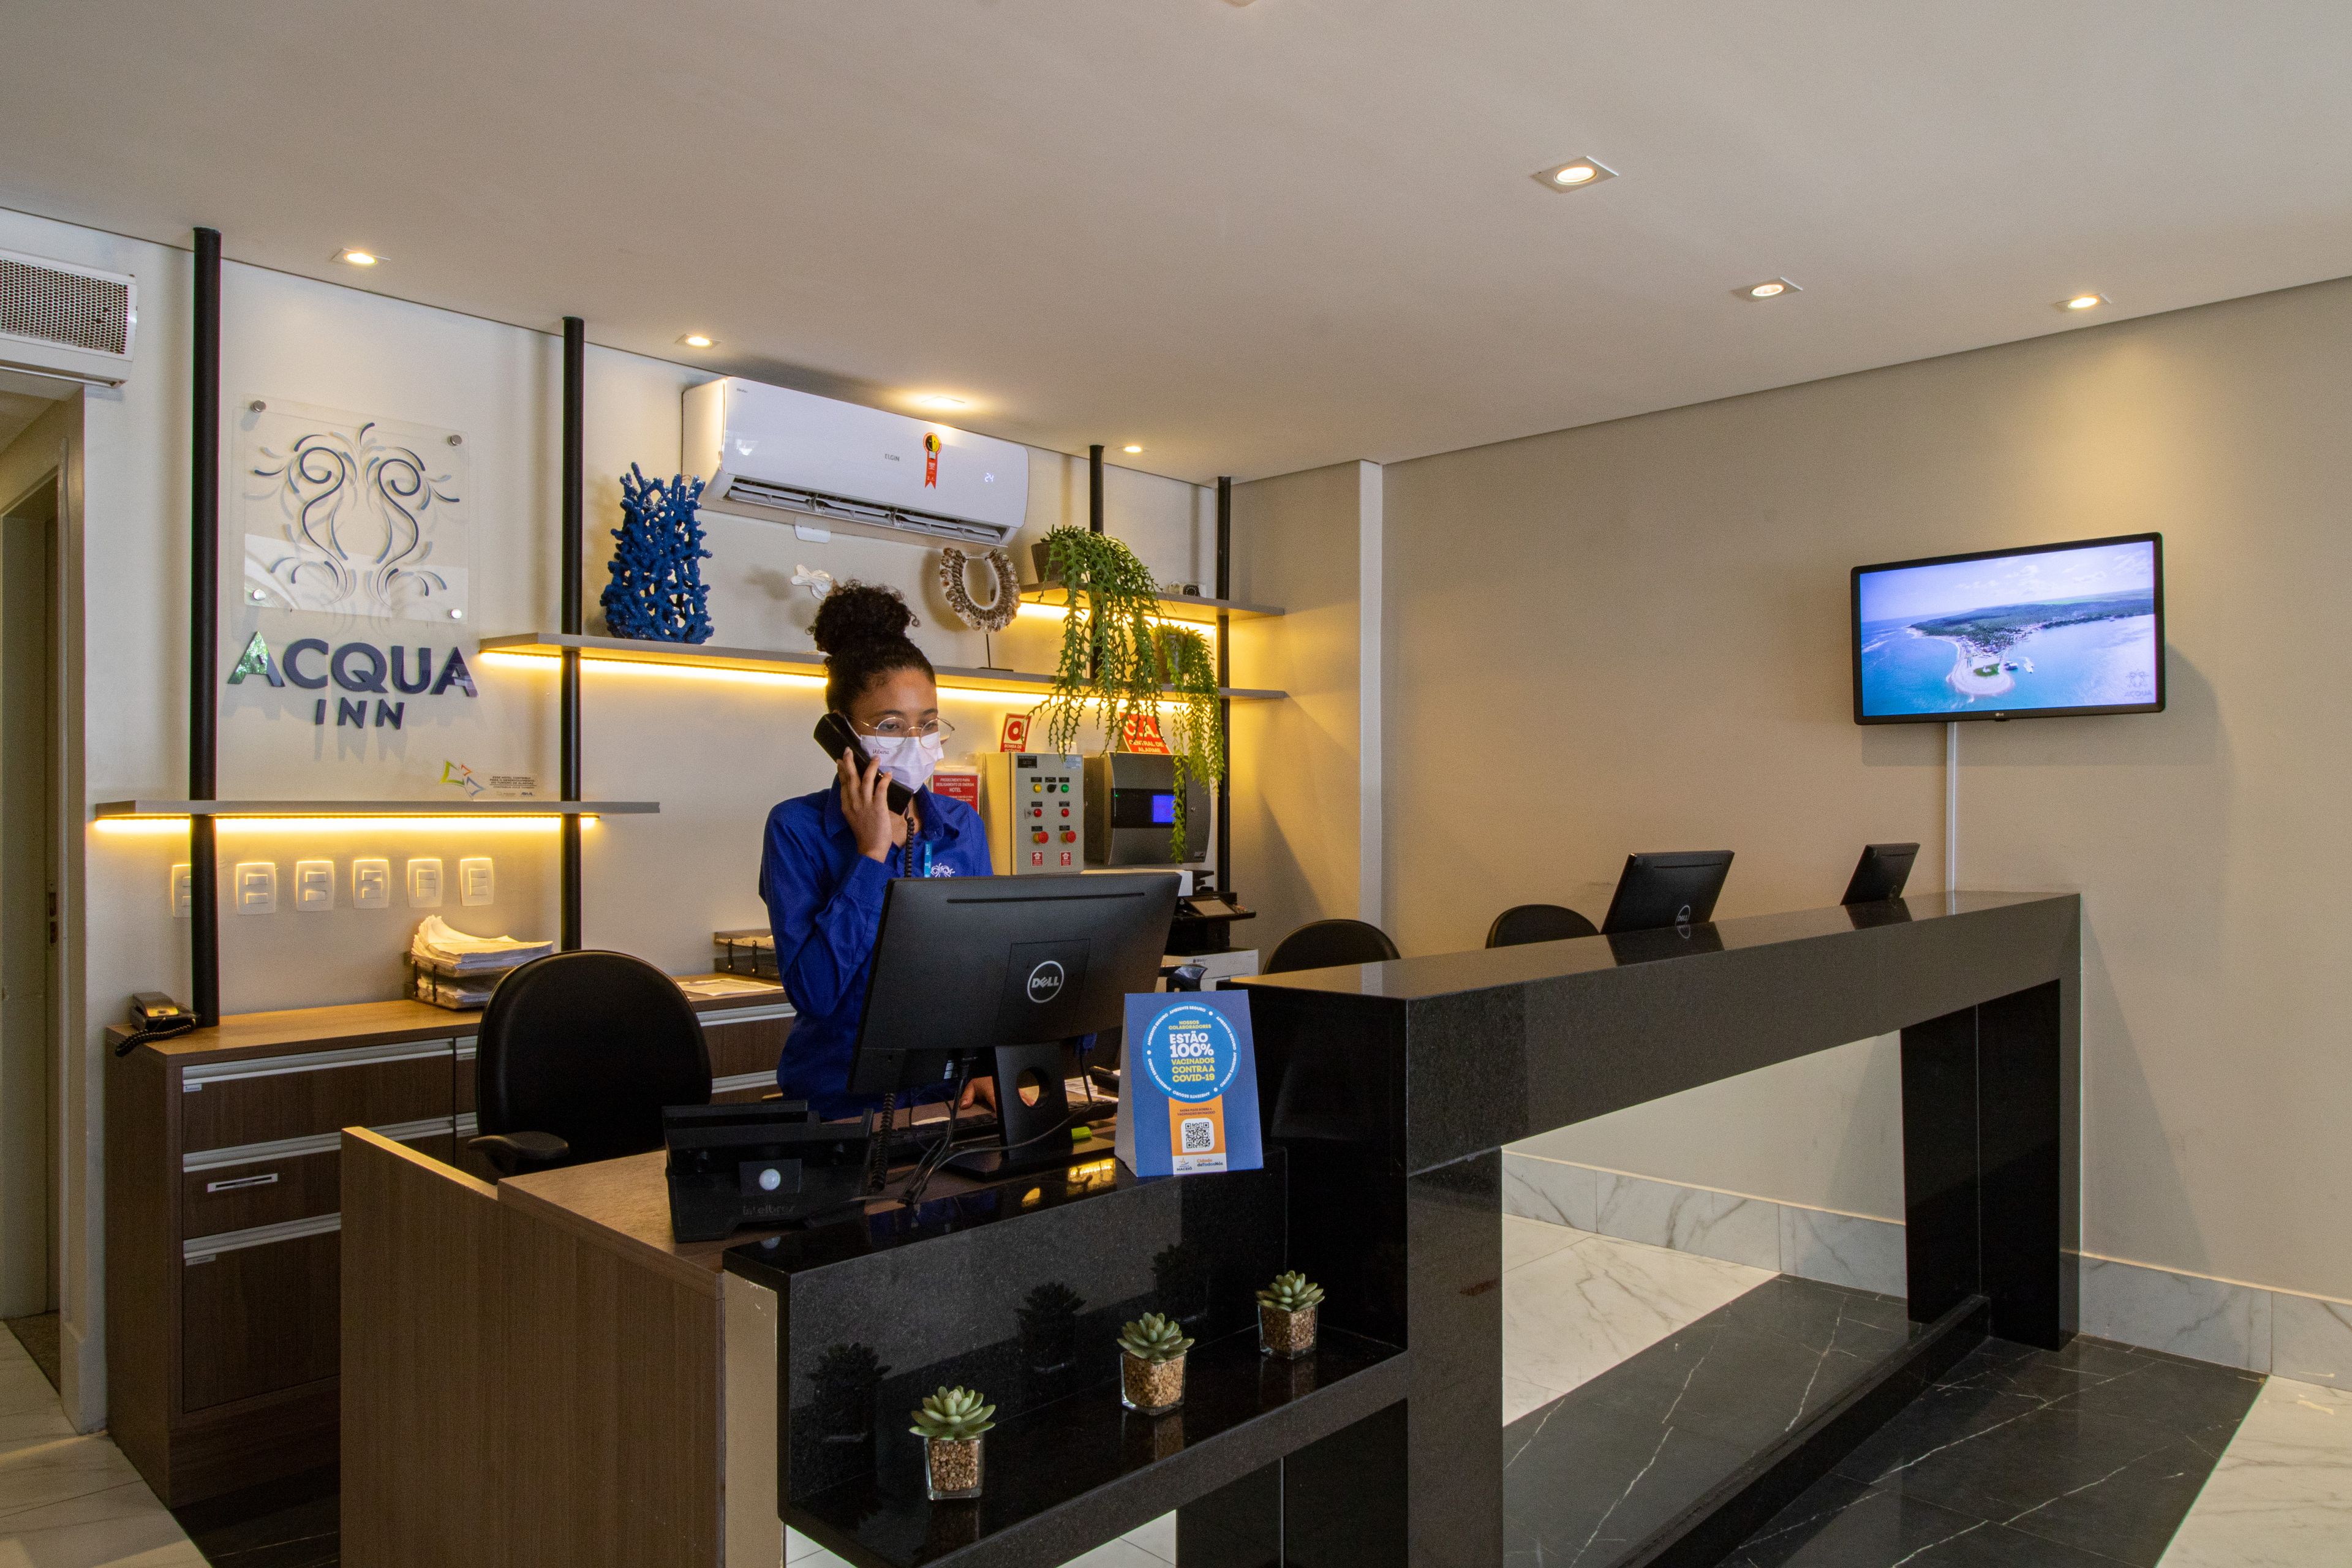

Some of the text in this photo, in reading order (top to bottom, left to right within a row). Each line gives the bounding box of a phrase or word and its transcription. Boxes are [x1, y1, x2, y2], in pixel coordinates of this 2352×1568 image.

[984, 472, 994, 482] 24
[227, 631, 478, 697] ACQUA
[315, 697, 405, 729] INN
[1031, 976, 1059, 988] DELL
[1155, 1013, 1169, 1027] SEGURO
[1169, 1031, 1208, 1044] ESTÃO
[1170, 1043, 1214, 1058] 100%
[1172, 1073, 1215, 1083] COVID-19
